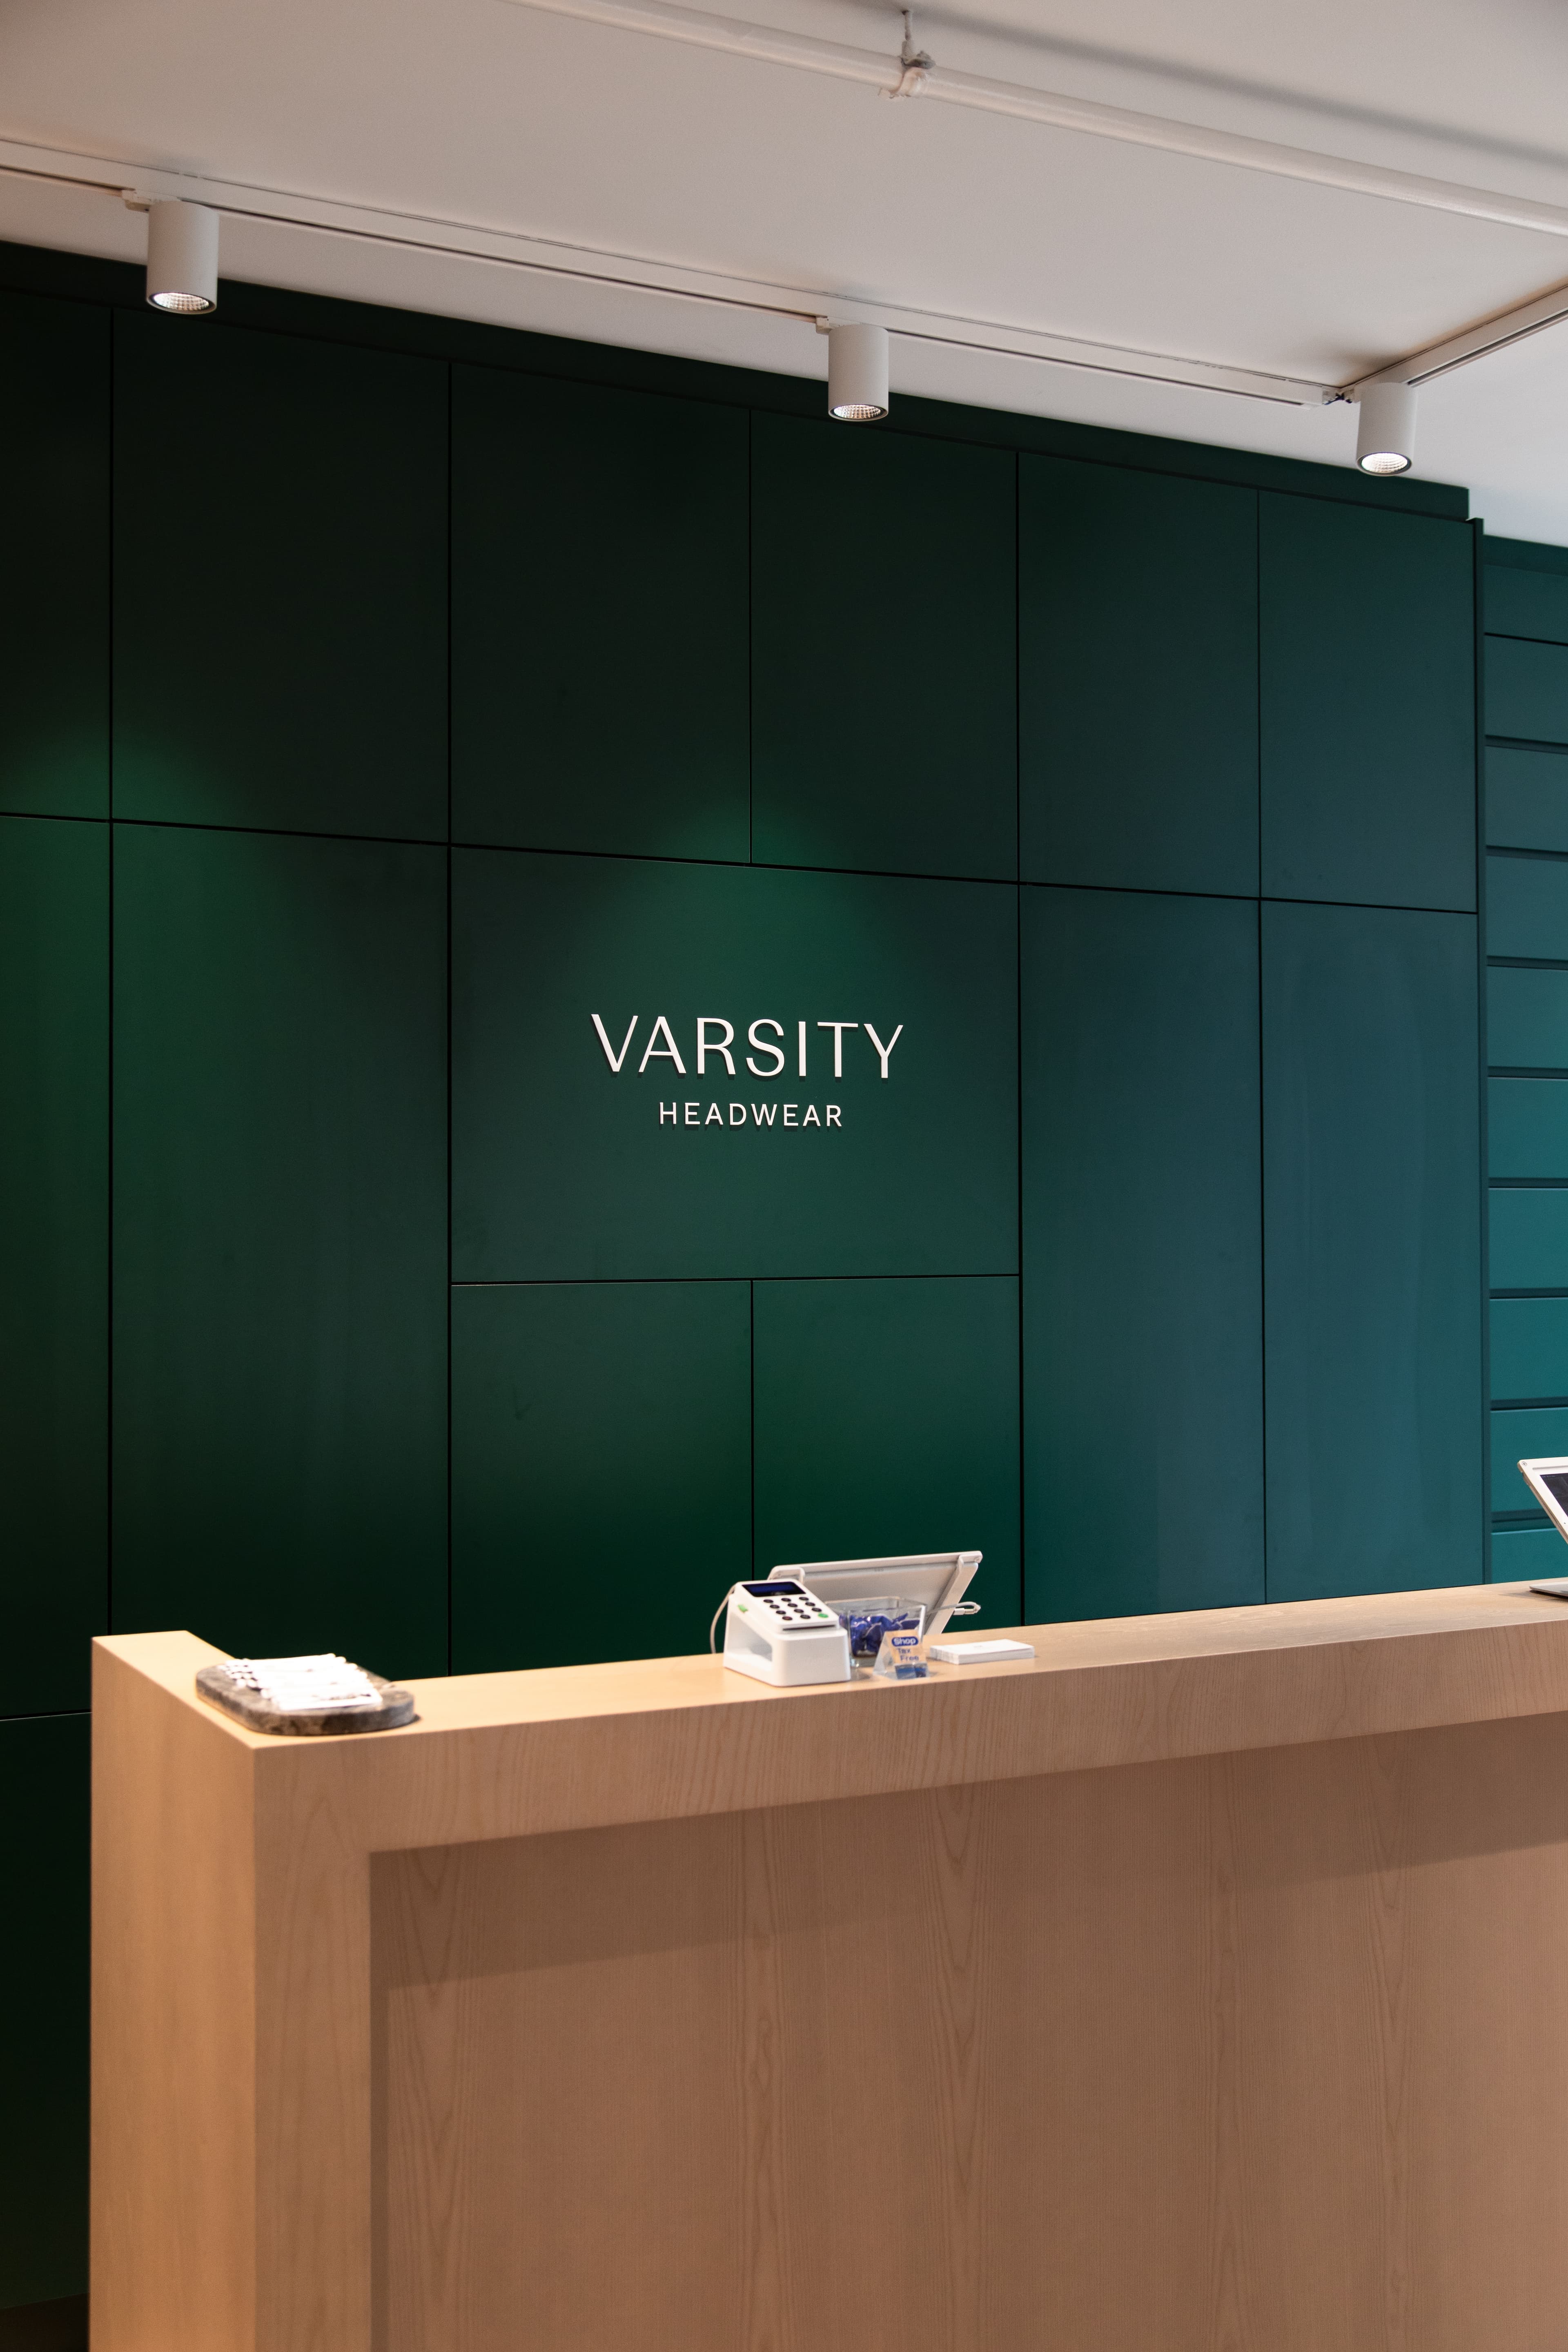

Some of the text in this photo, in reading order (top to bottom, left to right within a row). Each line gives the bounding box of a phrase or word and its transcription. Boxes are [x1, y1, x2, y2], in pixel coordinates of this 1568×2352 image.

[591, 1014, 903, 1078] VARSITY
[659, 1102, 842, 1127] HEADWEAR
[893, 1637, 916, 1645] Shop
